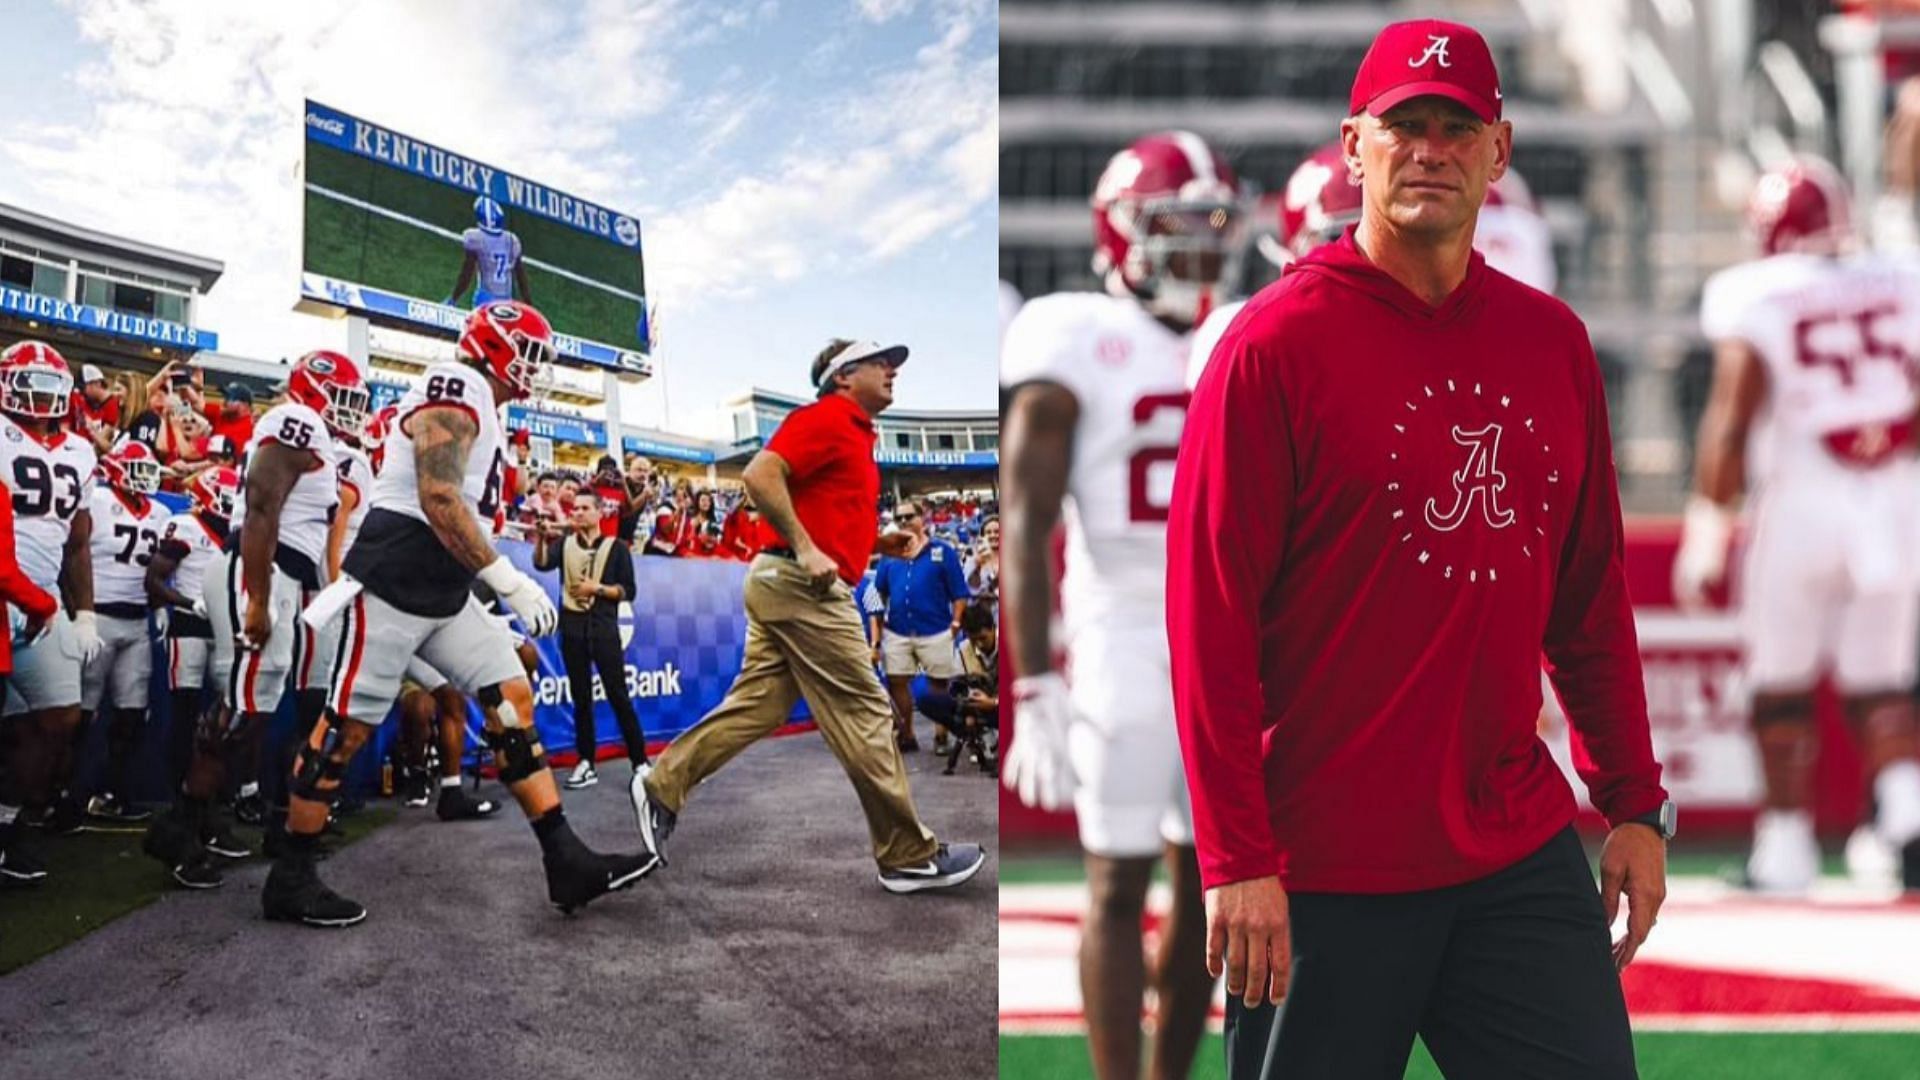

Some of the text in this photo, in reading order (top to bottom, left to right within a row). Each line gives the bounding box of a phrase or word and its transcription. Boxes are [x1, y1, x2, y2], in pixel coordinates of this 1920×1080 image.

[1408, 34, 1452, 68] A
[354, 121, 494, 194] KENTUCKY
[506, 175, 609, 235] WILDCATS
[493, 252, 507, 282] 7
[94, 307, 197, 345] WILDCATS
[1794, 303, 1919, 391] 55
[279, 416, 315, 449] 55
[12, 455, 82, 520] 93
[114, 524, 158, 565] 73
[624, 662, 681, 699] Bank
